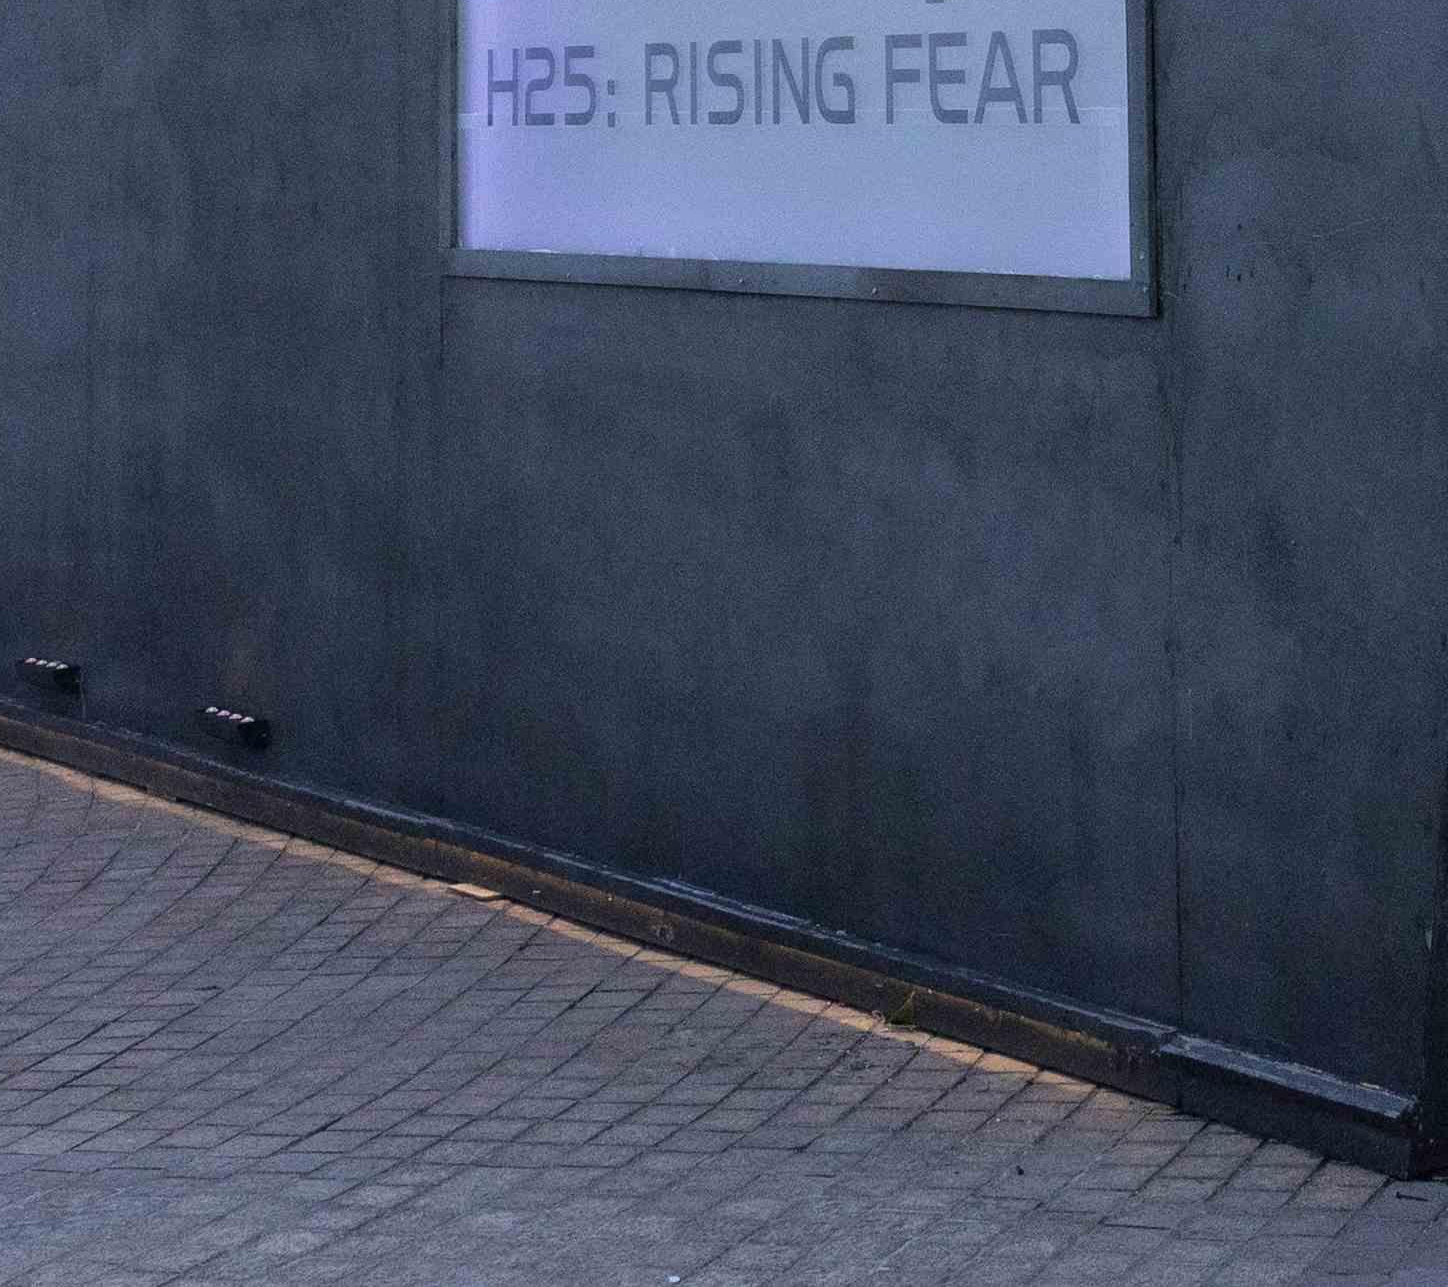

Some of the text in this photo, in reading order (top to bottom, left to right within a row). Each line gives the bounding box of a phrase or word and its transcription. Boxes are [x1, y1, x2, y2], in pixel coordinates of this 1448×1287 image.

[486, 28, 1081, 128] H25: RISING FEAR
